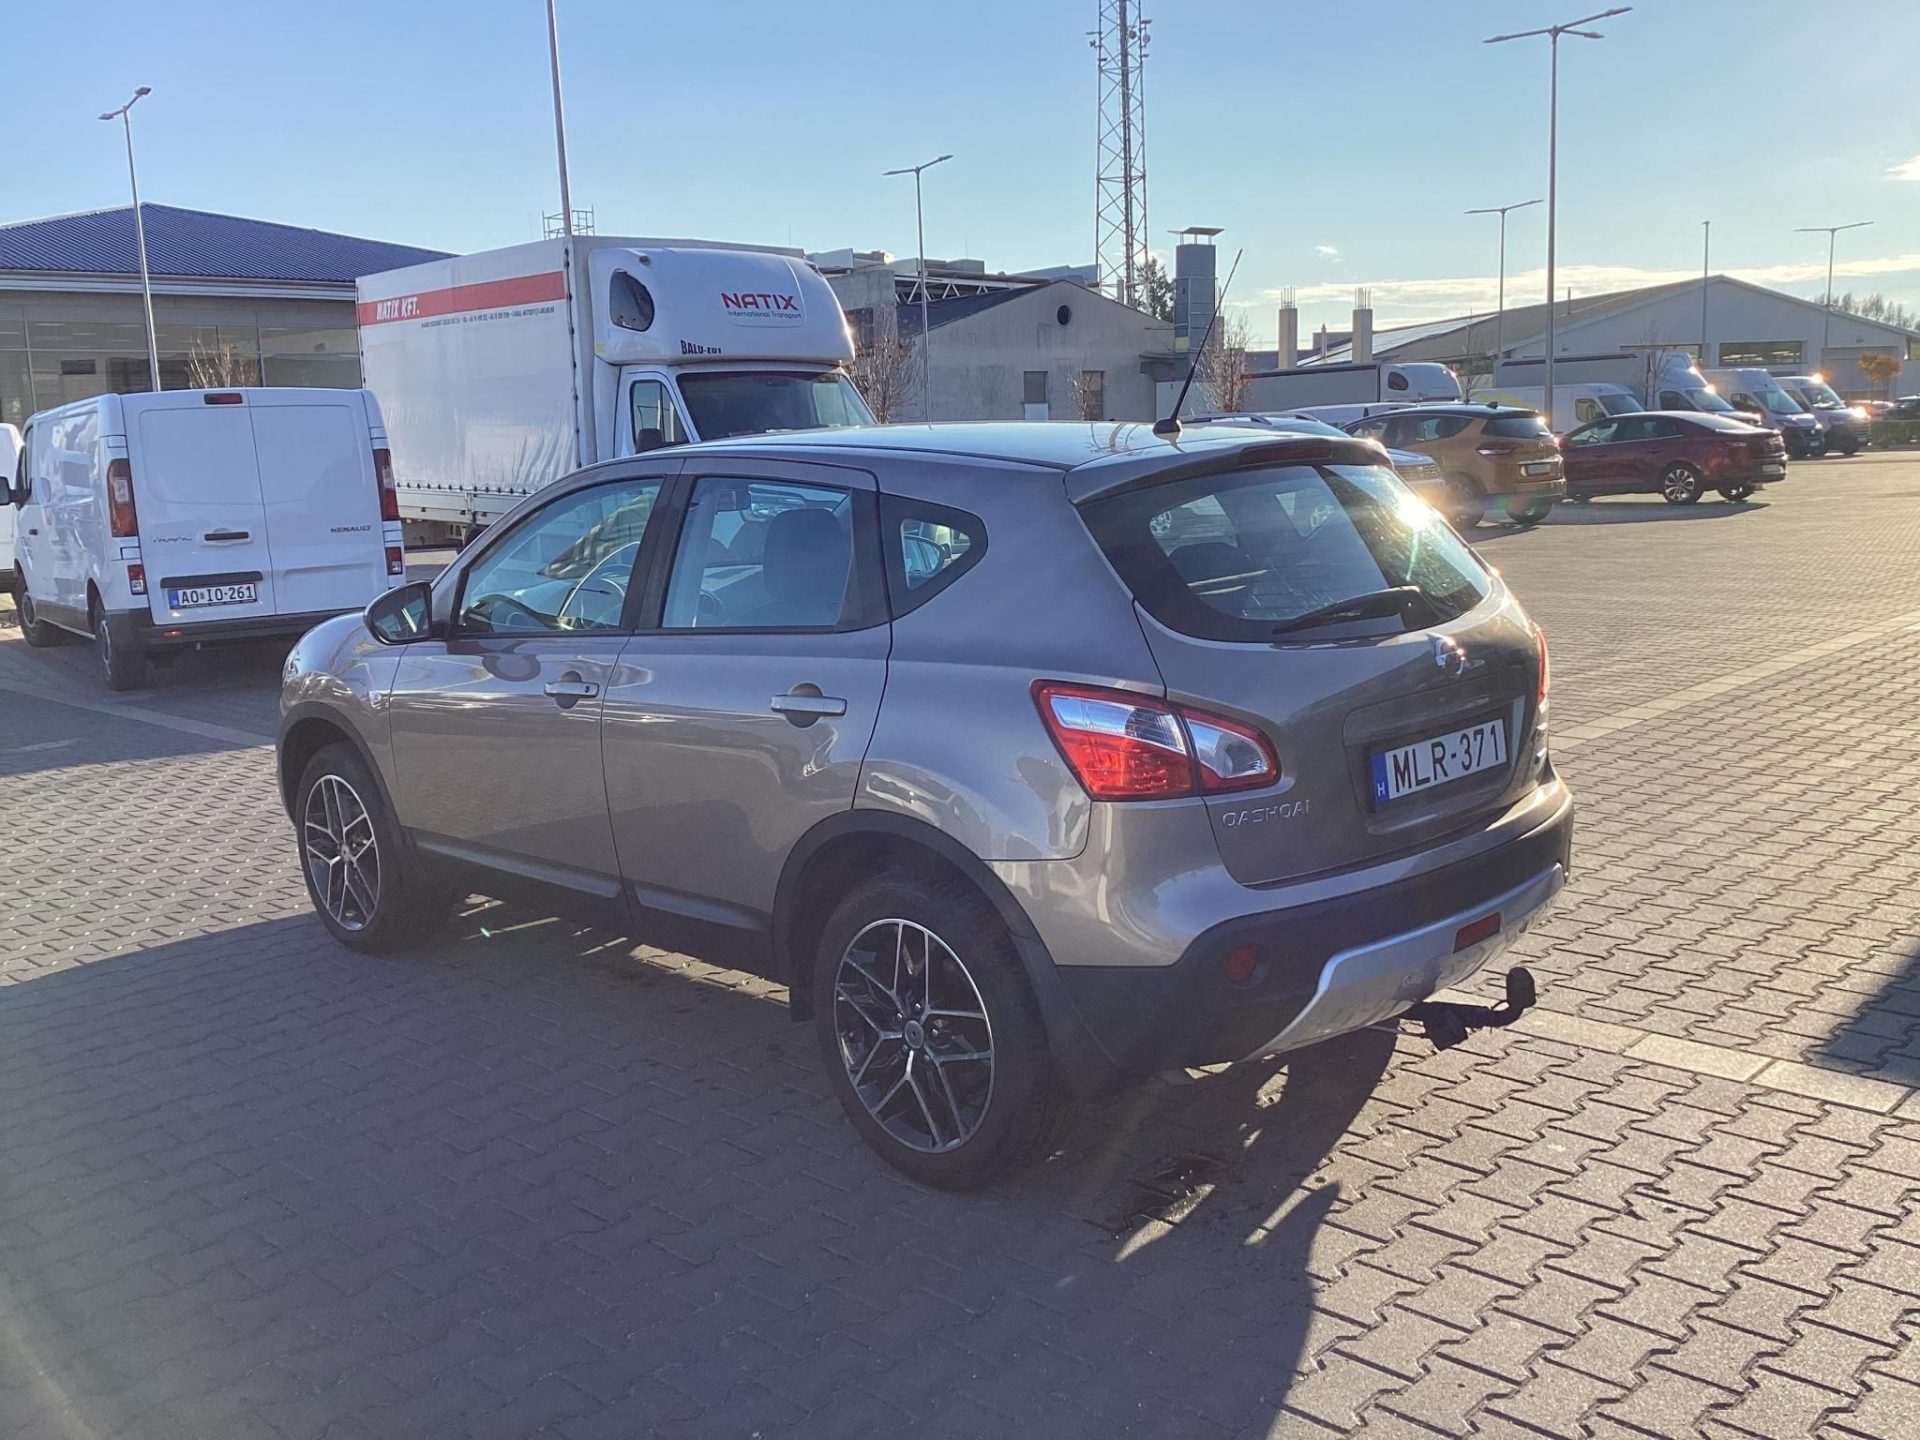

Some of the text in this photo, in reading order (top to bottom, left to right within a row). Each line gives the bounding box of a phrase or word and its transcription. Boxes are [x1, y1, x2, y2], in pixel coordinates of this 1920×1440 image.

[377, 300, 400, 320] NATIX
[721, 293, 799, 310] NATIX
[728, 310, 802, 319] International Transport
[181, 590, 199, 604] AO
[1377, 724, 1499, 797] H MLR-371
[1222, 799, 1310, 826] QASHQAI
